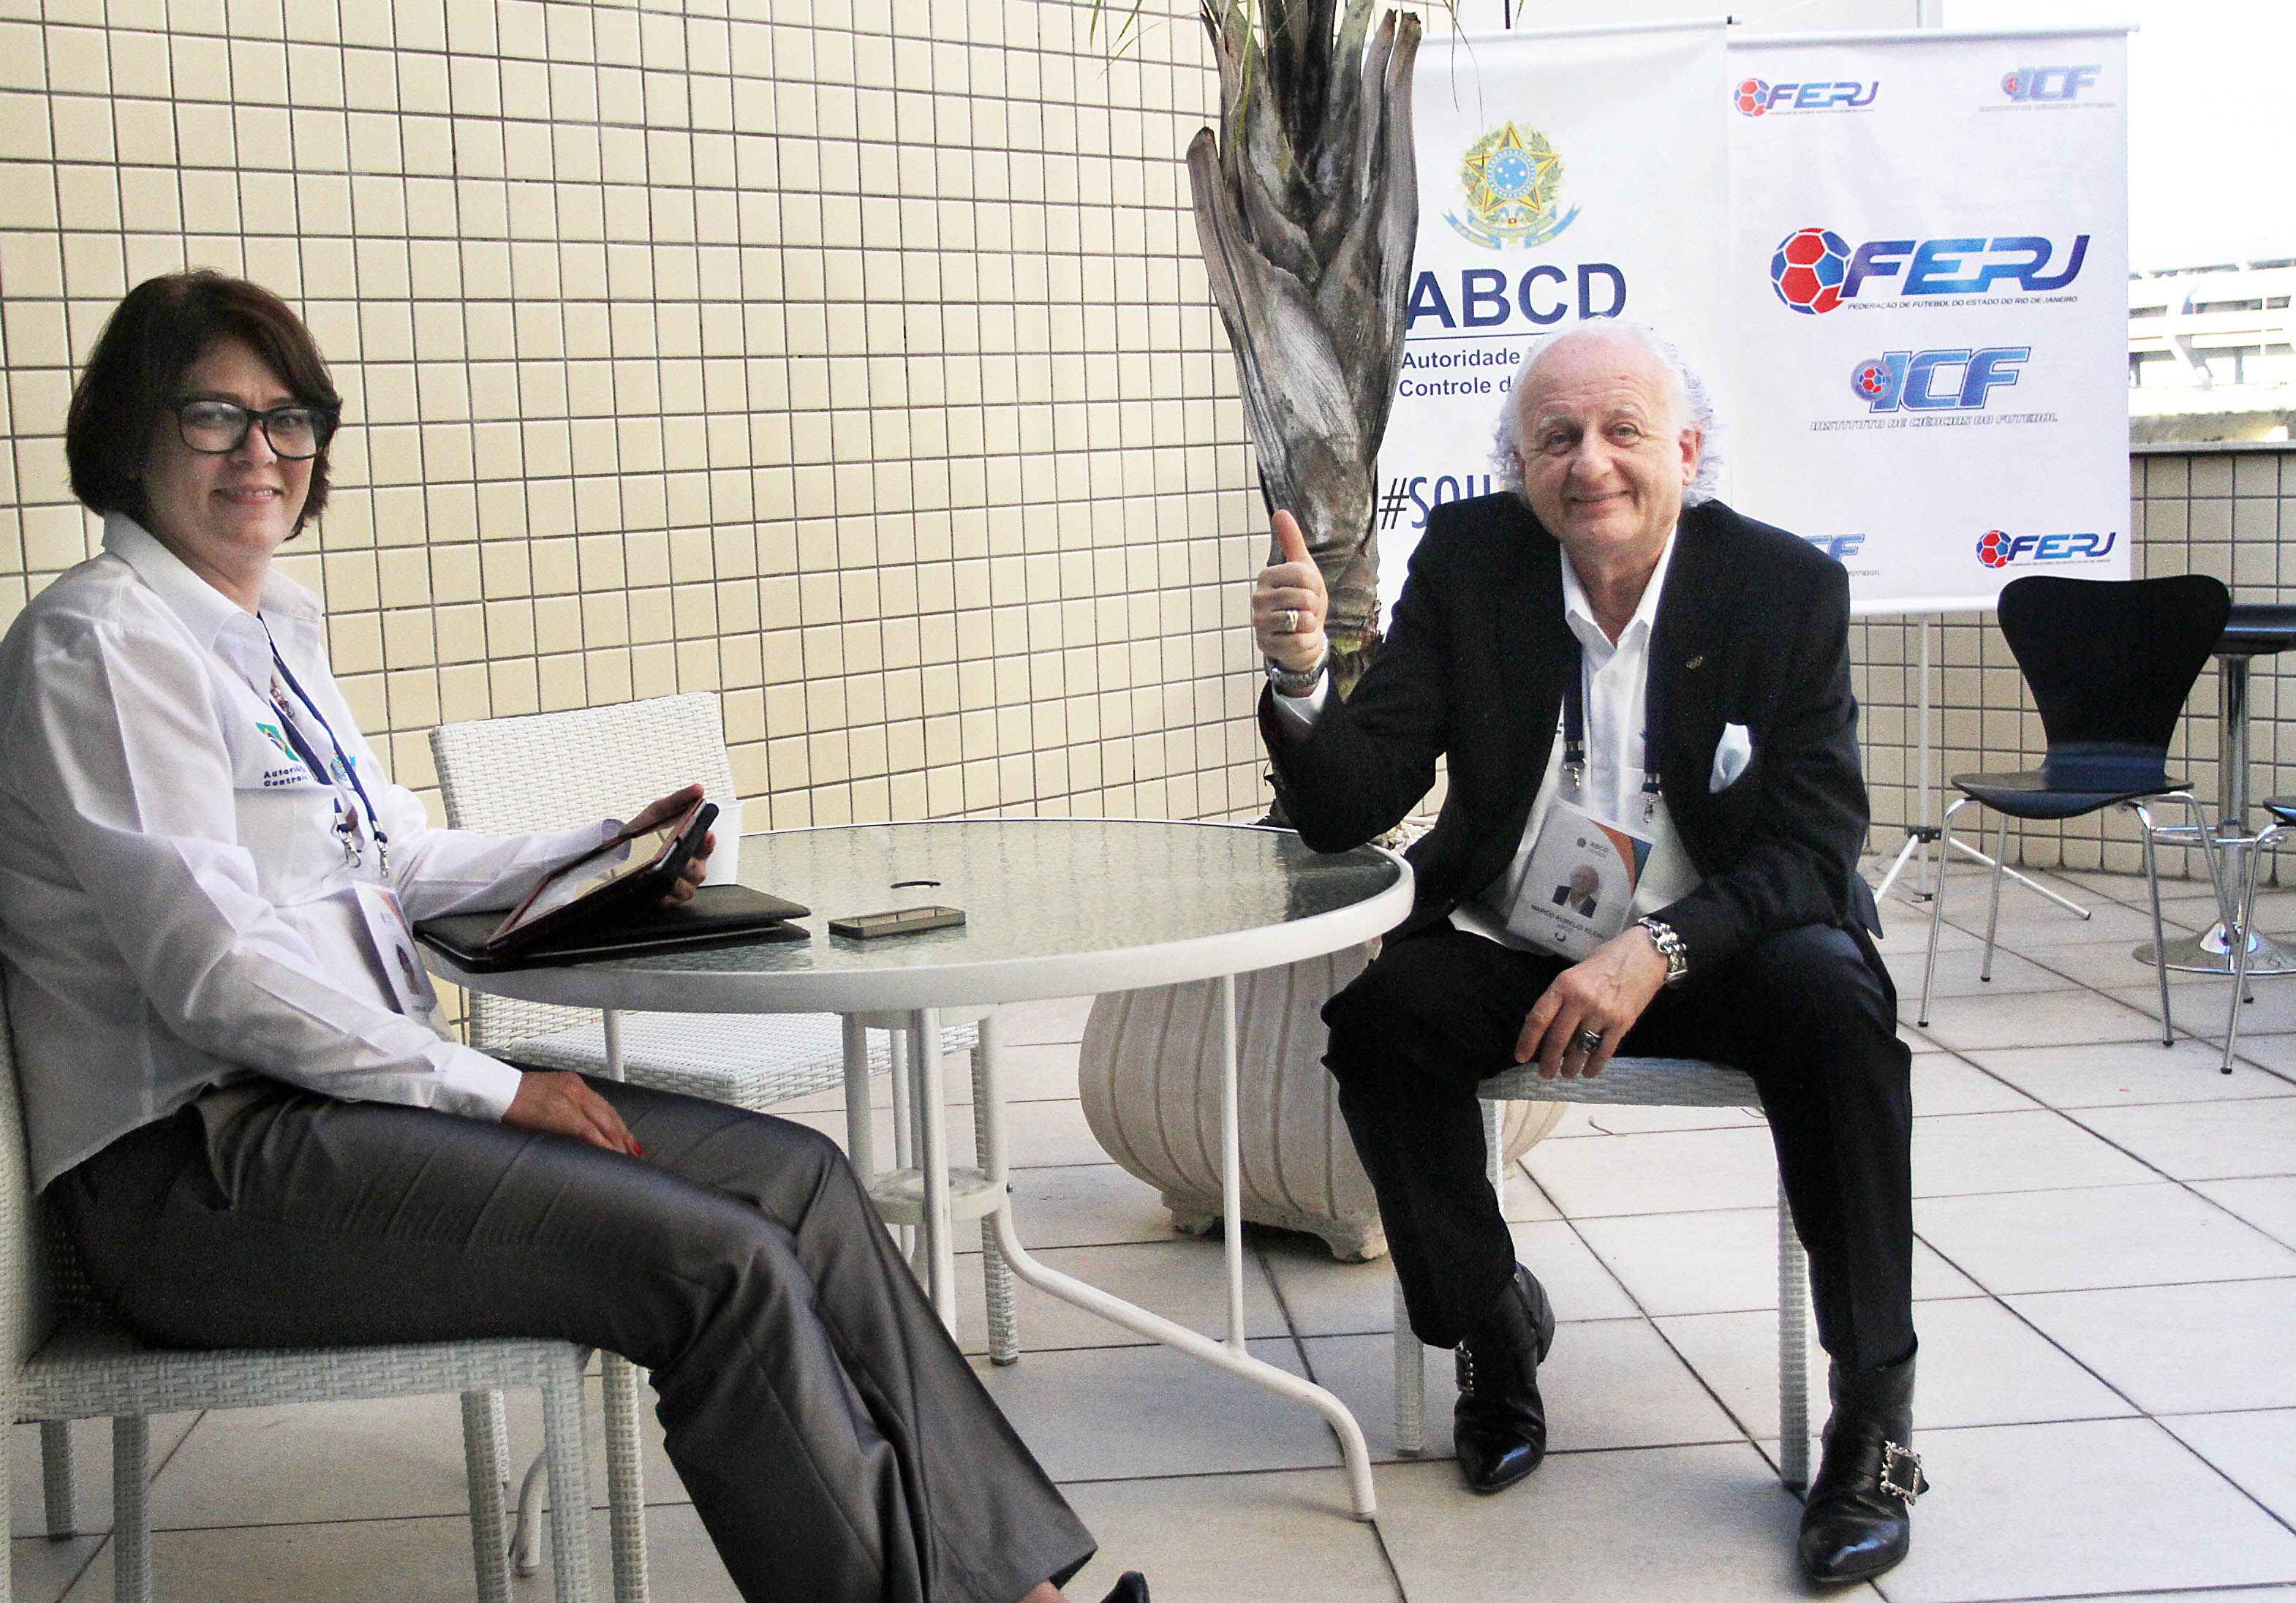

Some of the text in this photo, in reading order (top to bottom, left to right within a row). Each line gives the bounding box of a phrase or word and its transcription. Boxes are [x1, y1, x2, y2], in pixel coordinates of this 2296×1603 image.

[1766, 81, 1879, 110] FERJ
[1839, 234, 2091, 299] FERJ
[1406, 263, 1627, 330] ABCD
[1912, 300, 1950, 308] FUTEBOL
[1965, 298, 1999, 306] ESTADO
[1401, 347, 1520, 369] Autoridade
[1399, 377, 1491, 397] Controle
[1869, 347, 2031, 413] ICF
[2006, 532, 2116, 562] FERJ
